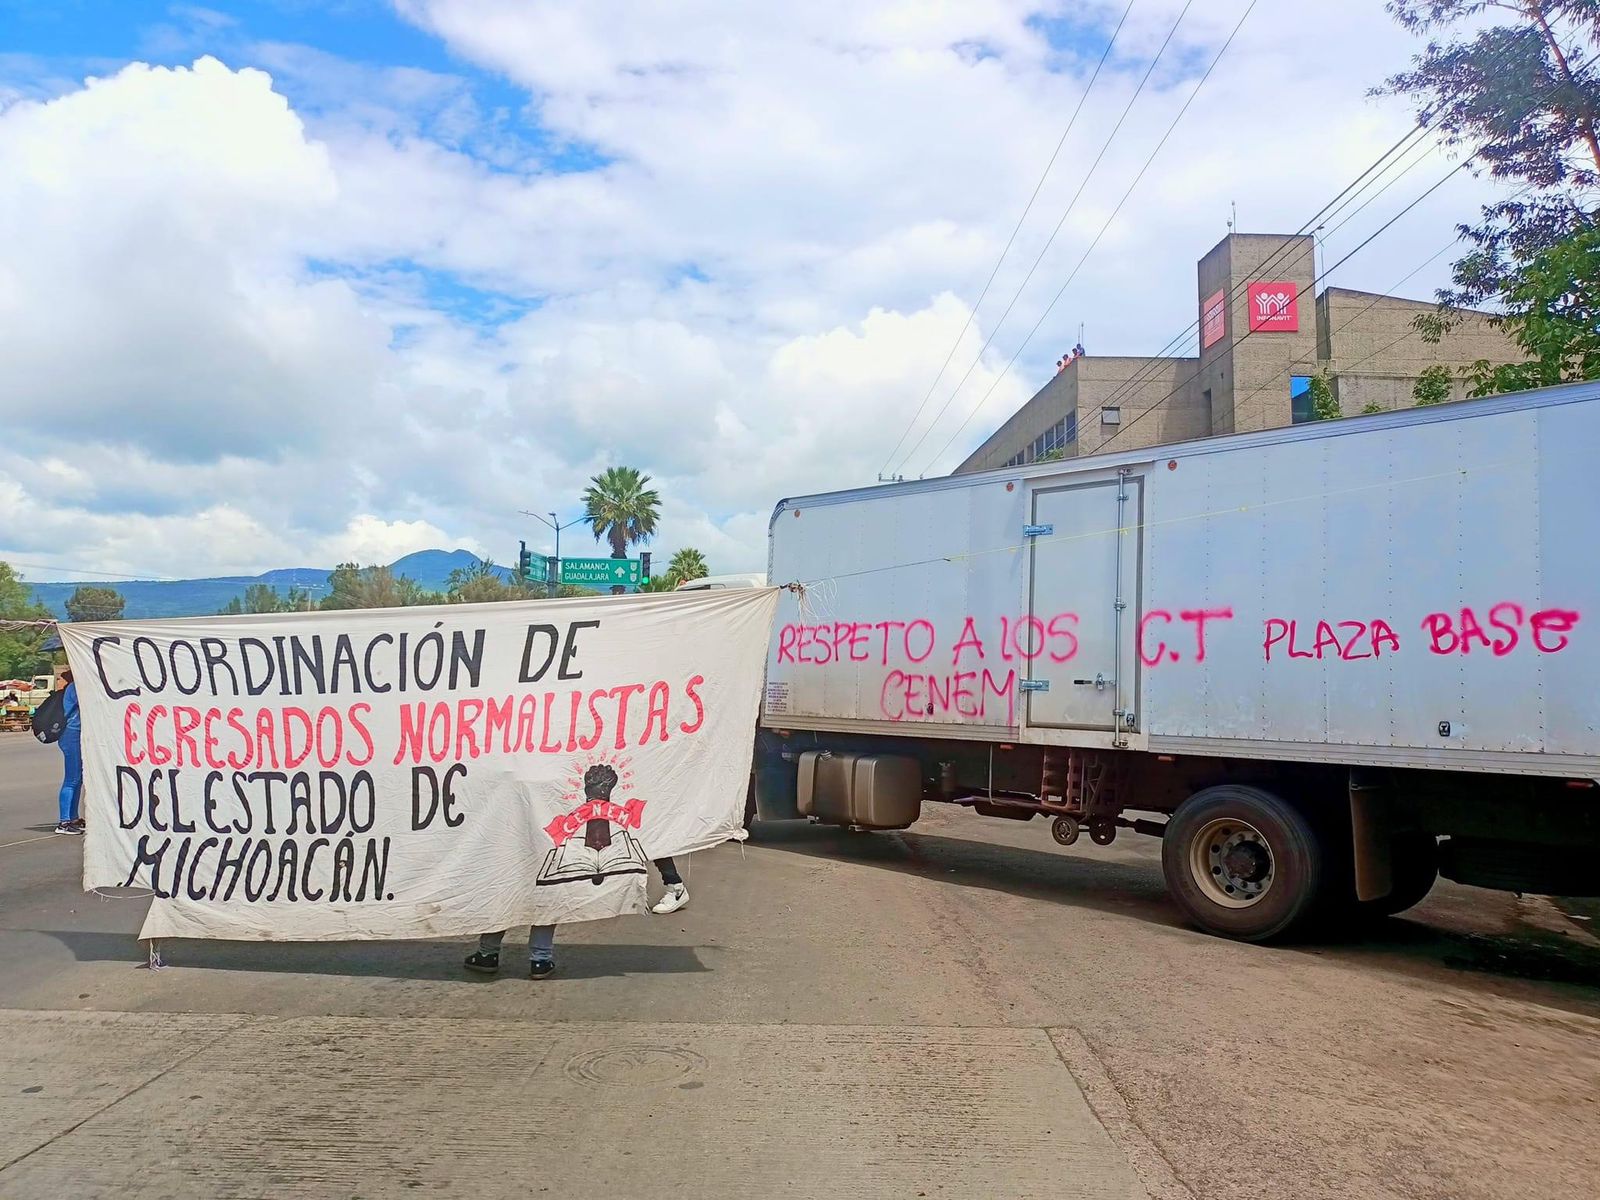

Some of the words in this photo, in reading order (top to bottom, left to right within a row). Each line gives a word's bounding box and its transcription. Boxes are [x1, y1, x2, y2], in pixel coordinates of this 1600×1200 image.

[564, 562, 610, 571] SALAMANCA
[564, 572, 610, 581] GUADALAJARA
[92, 621, 486, 700] COORDINACIÓN
[518, 620, 601, 683] DE
[776, 618, 935, 666] RESPETO
[952, 615, 985, 667] A
[1262, 618, 1401, 661] PLAZA
[123, 702, 376, 769] EGRESADOS
[393, 674, 705, 766] NORMALISTAS
[880, 668, 1016, 727] CENEM
[116, 765, 197, 833] DEL
[204, 770, 376, 835] ESTADO
[411, 763, 468, 831] DE
[561, 802, 631, 834] CENEM
[116, 830, 395, 902] MICHOACÁN.
